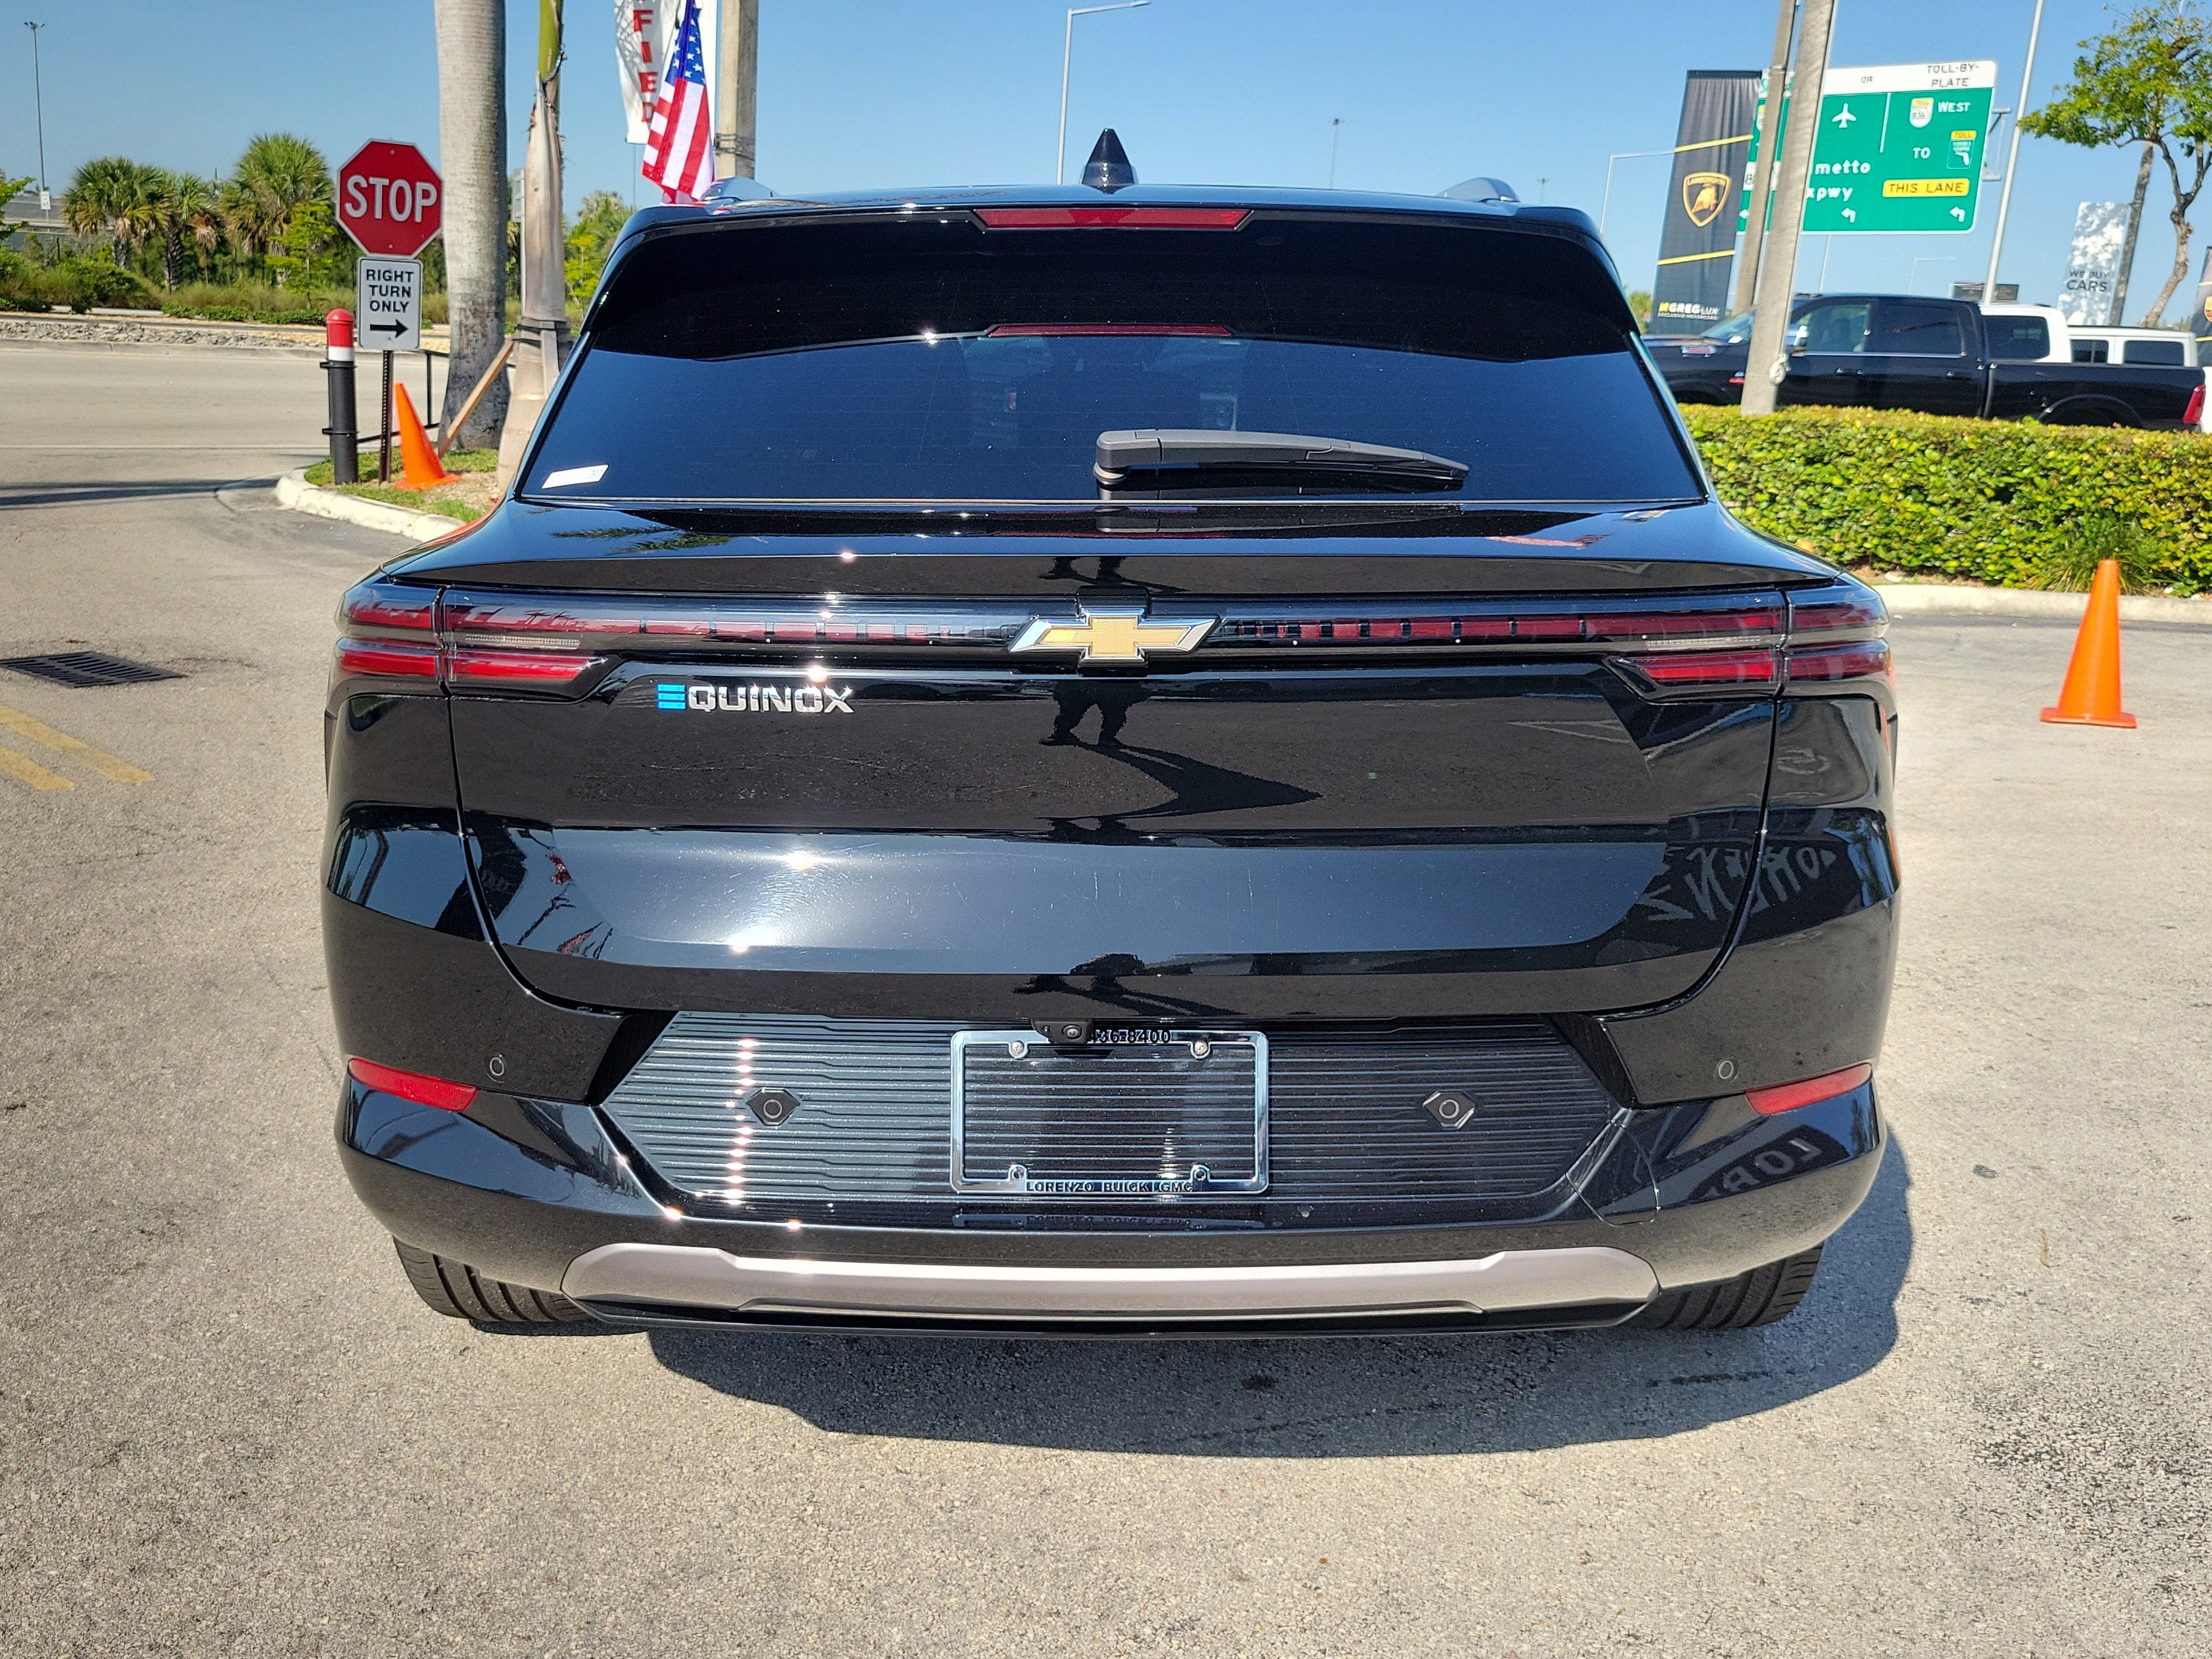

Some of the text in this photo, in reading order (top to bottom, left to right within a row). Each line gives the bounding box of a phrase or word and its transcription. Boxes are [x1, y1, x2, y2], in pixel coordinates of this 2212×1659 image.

[633, 1, 658, 123] FIED
[1860, 76, 1874, 84] OR
[1931, 77, 1970, 88] PLATE
[1938, 101, 1971, 113] WEST
[1912, 146, 1931, 159] TO
[1814, 159, 1871, 175] metto
[1805, 187, 1854, 202] xpwy
[1889, 182, 1964, 194] THIS LANE
[344, 174, 438, 223] STOP
[366, 269, 414, 283] RIGHT
[2069, 270, 2108, 279] WE BUY
[369, 285, 411, 298] TURN
[2067, 280, 2108, 292] CARS
[370, 300, 409, 314] ONLY
[657, 684, 855, 713] EQUINOX
[1026, 1181, 1193, 1192] LORENZO BUICK GMC
